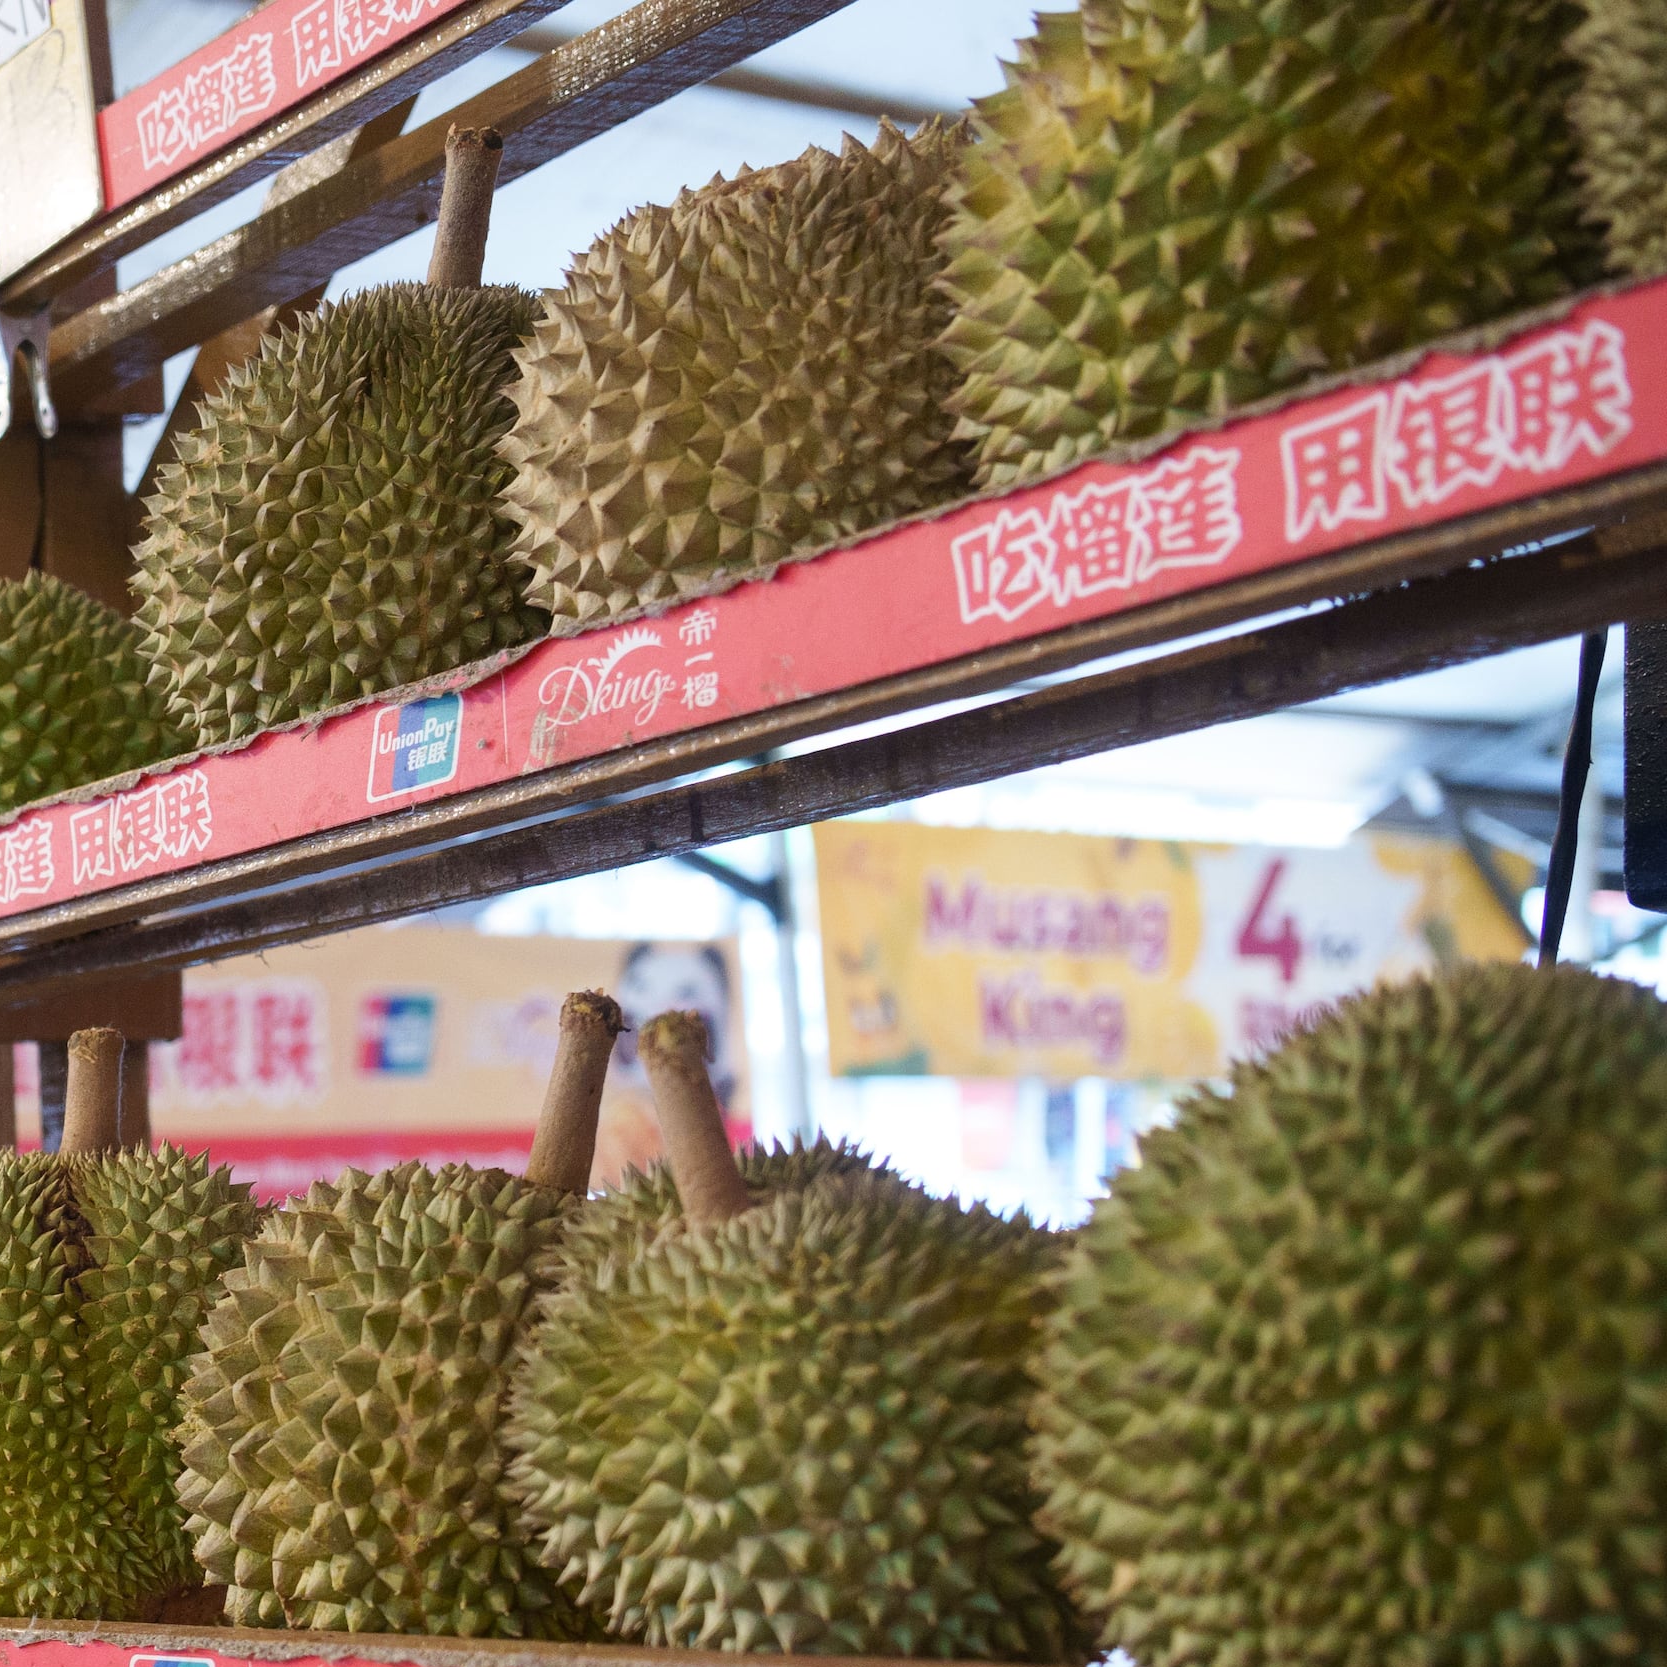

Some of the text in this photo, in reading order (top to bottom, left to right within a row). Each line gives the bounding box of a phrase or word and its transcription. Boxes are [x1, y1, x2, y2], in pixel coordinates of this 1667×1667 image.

[1280, 318, 1634, 543] 用银联
[678, 607, 720, 711] 帝一榴
[379, 717, 455, 755] UnionPay
[407, 740, 448, 772] 银联
[70, 769, 213, 885] 用银联
[927, 875, 1168, 975] Musang
[1234, 856, 1302, 983] 4
[981, 973, 1128, 1065] King
